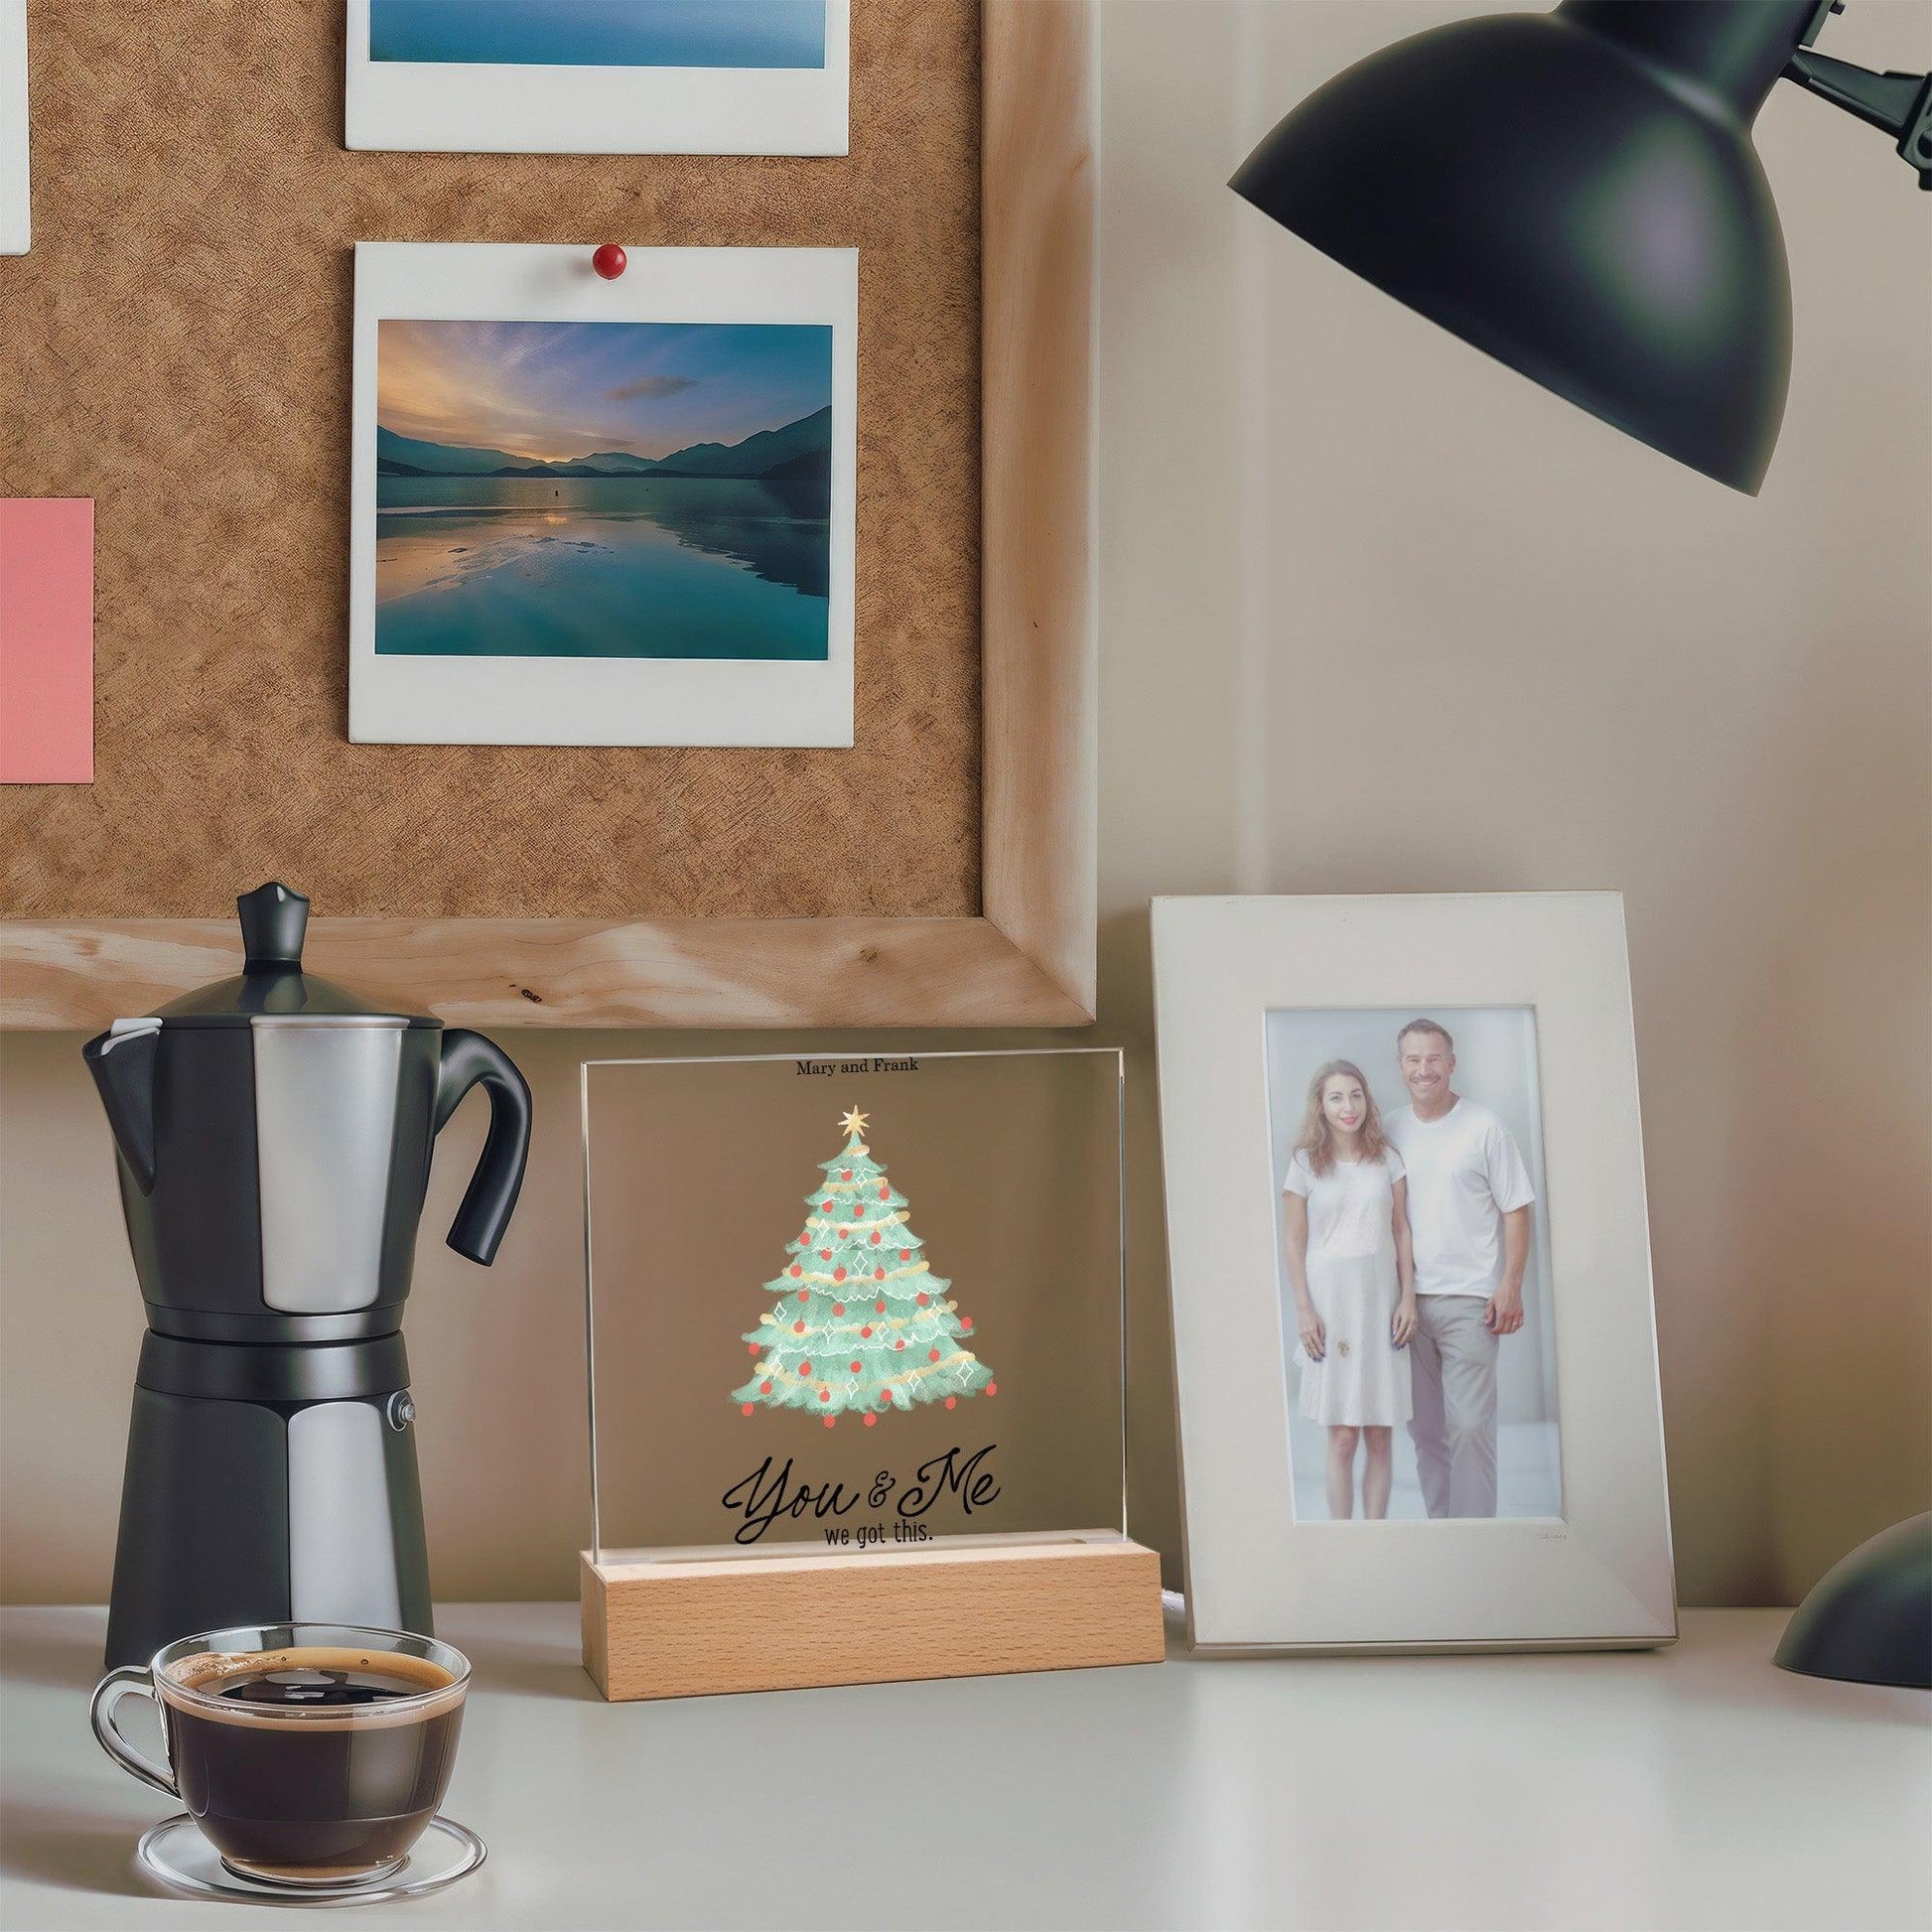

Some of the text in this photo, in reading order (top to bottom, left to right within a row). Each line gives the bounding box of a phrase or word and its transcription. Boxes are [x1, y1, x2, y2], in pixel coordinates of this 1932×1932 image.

[796, 1057, 919, 1076] Mary and Frank
[722, 1444, 1002, 1545] You & Me
[824, 1519, 934, 1549] we got this.
